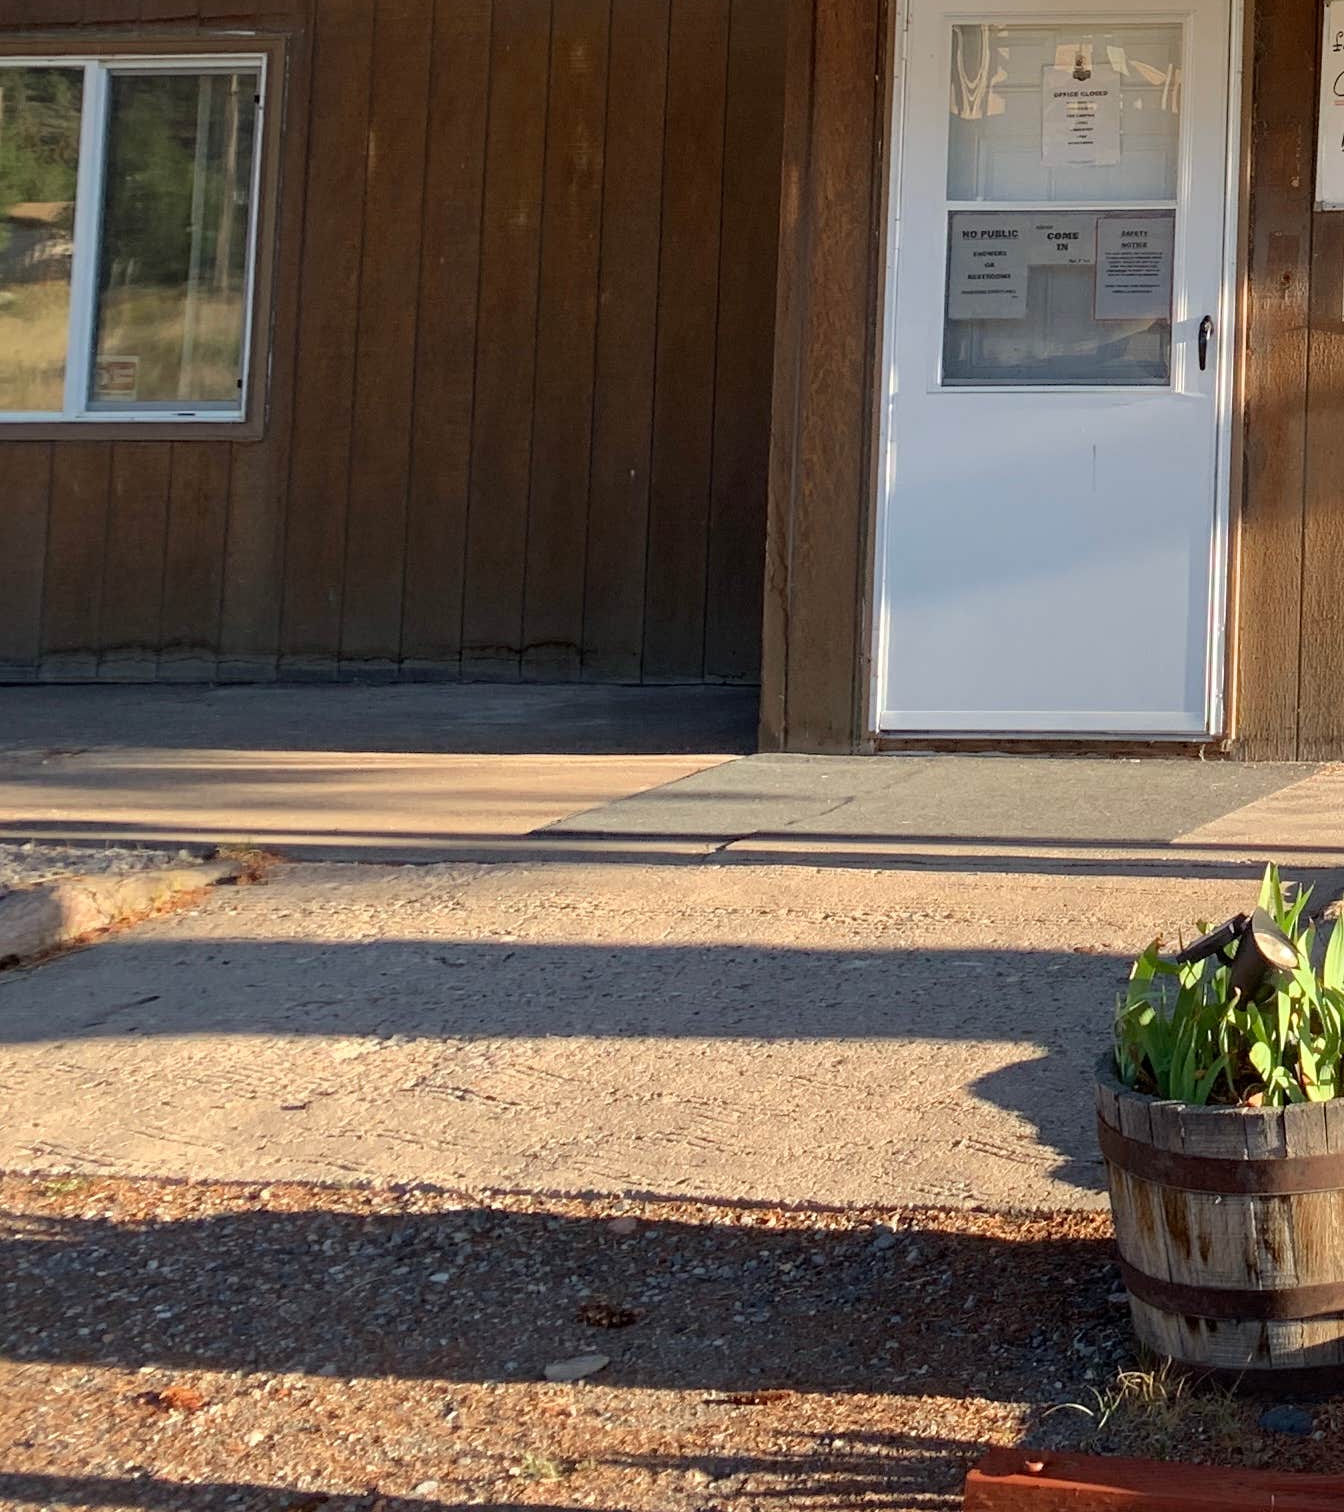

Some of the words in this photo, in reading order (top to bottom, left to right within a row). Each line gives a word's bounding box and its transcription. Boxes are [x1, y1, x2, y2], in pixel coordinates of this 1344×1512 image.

[962, 230, 978, 239] NO
[981, 229, 1019, 239] PUBLIC
[1047, 232, 1080, 240] COME
[1056, 243, 1069, 251] IN
